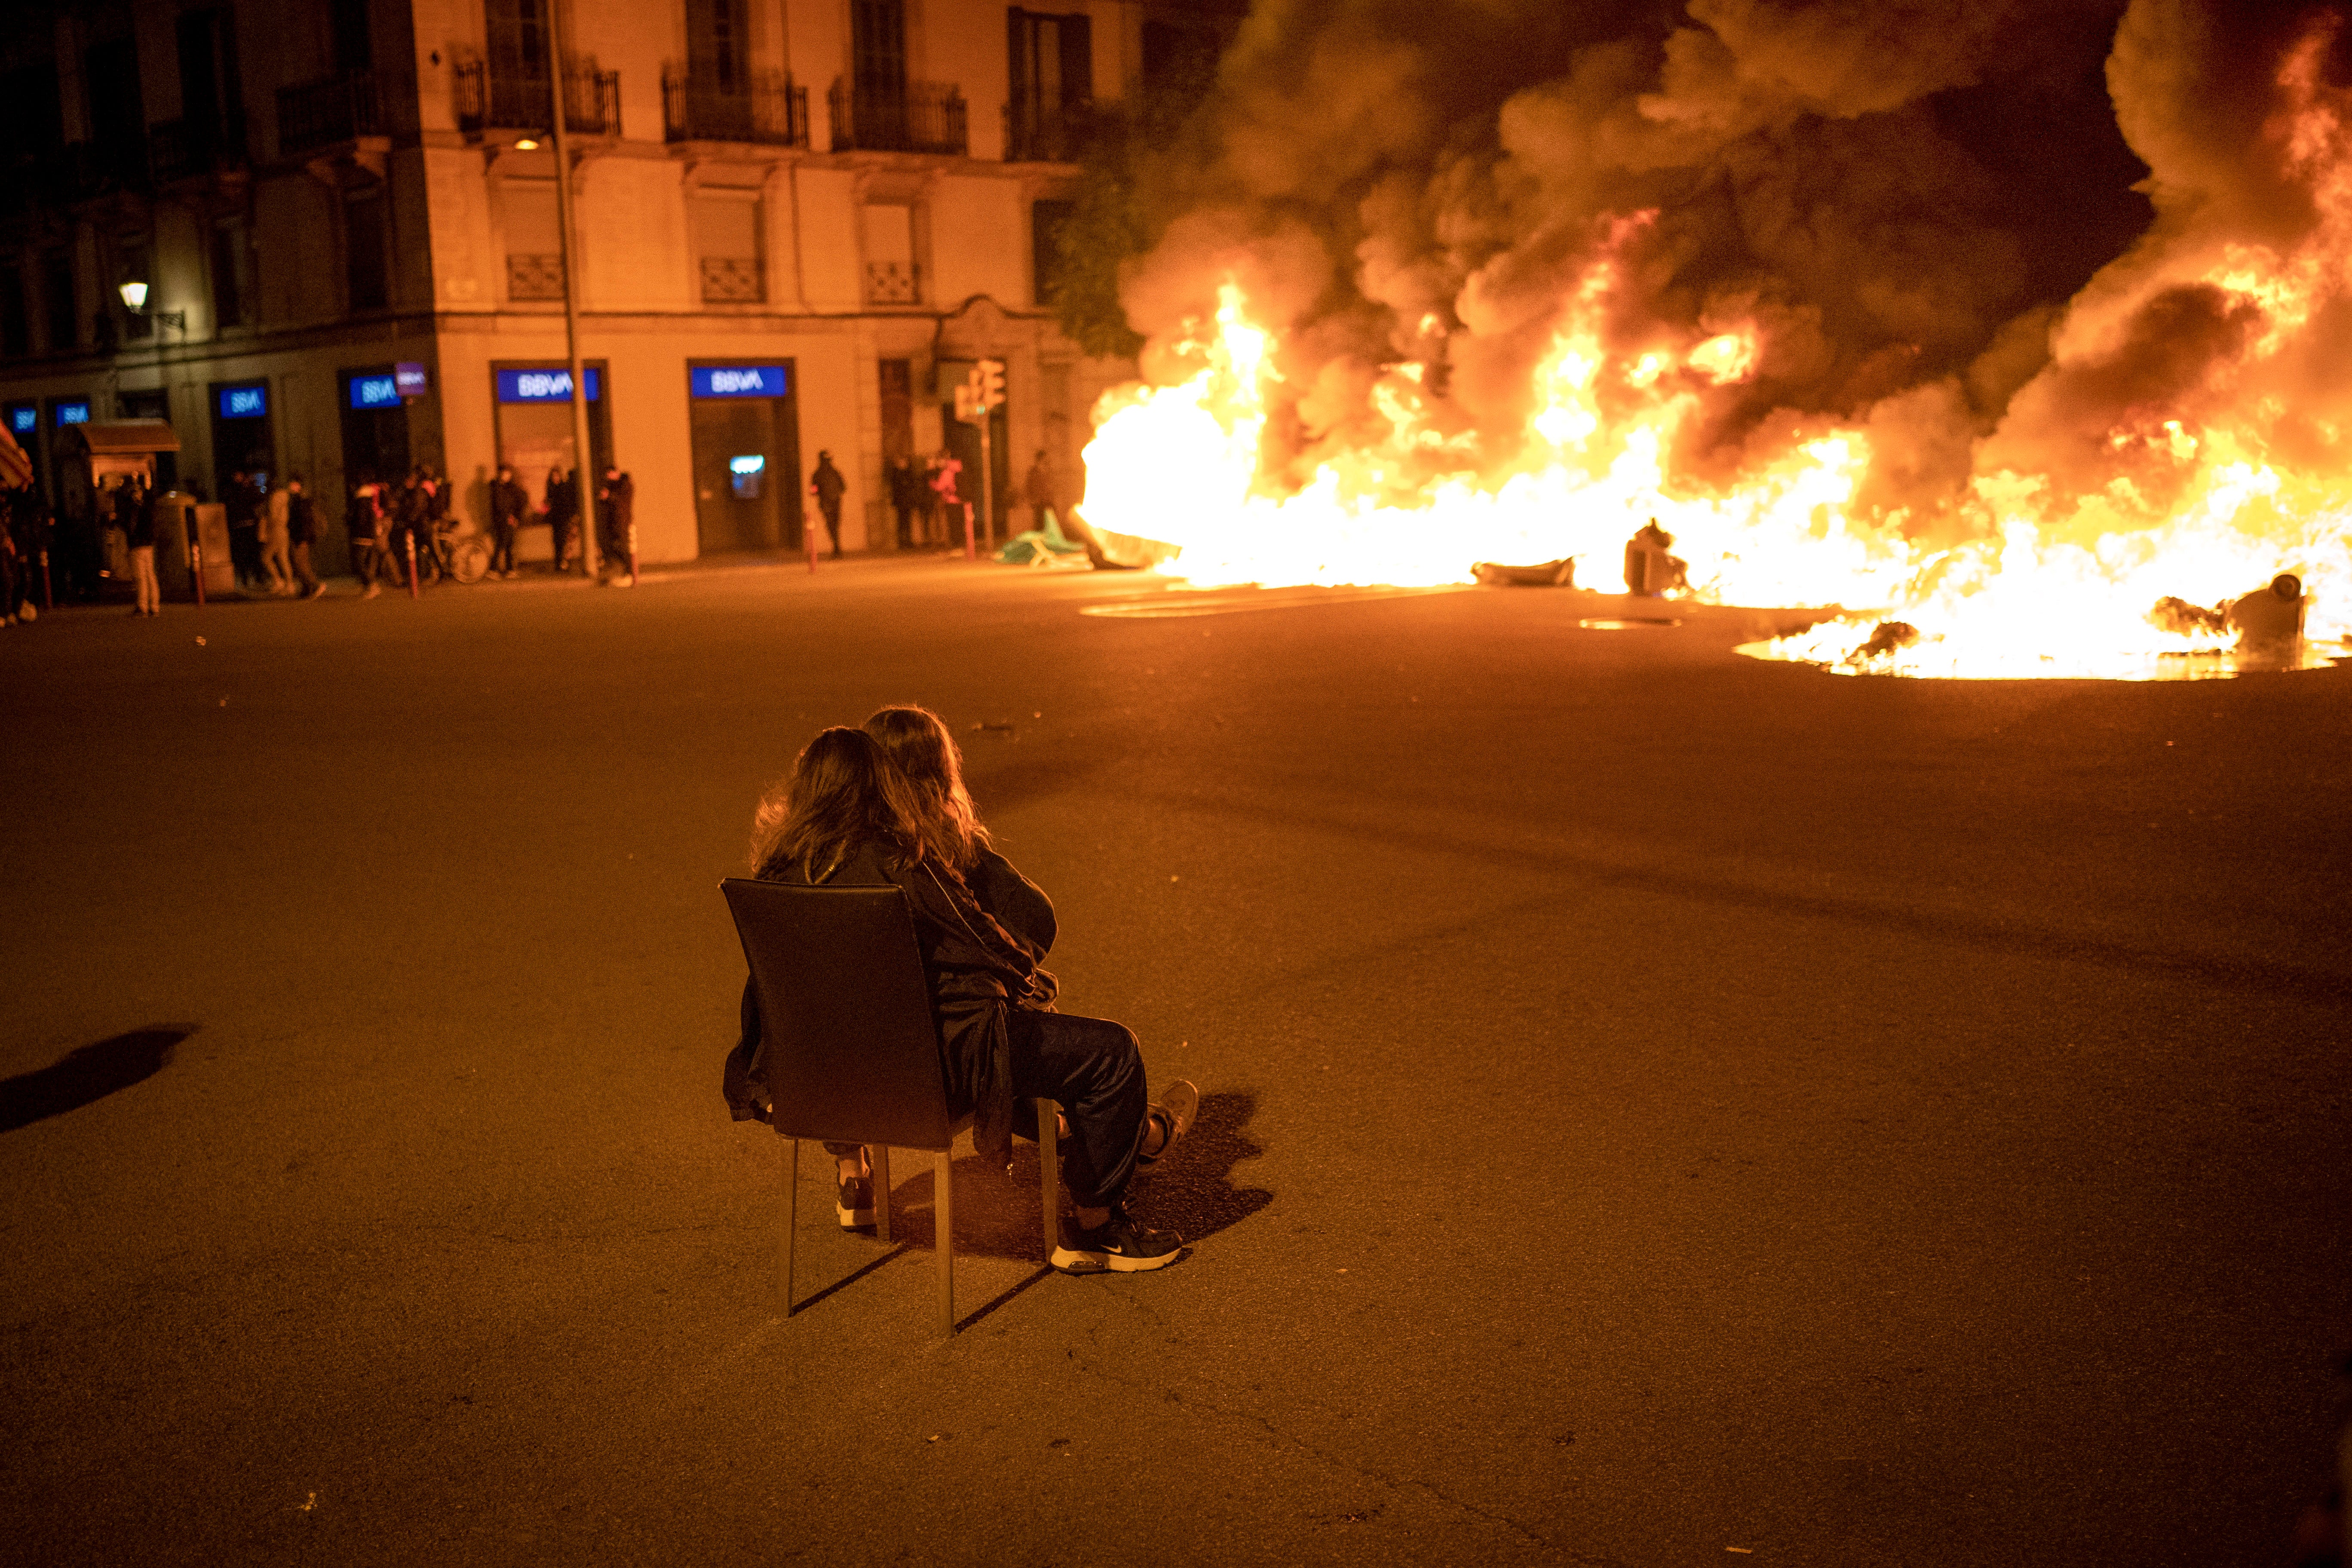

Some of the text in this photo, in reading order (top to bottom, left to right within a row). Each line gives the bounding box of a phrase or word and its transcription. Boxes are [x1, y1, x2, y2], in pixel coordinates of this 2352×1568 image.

[362, 378, 396, 403] BBVA
[518, 372, 573, 396] BBVA
[711, 369, 764, 392] BBVA
